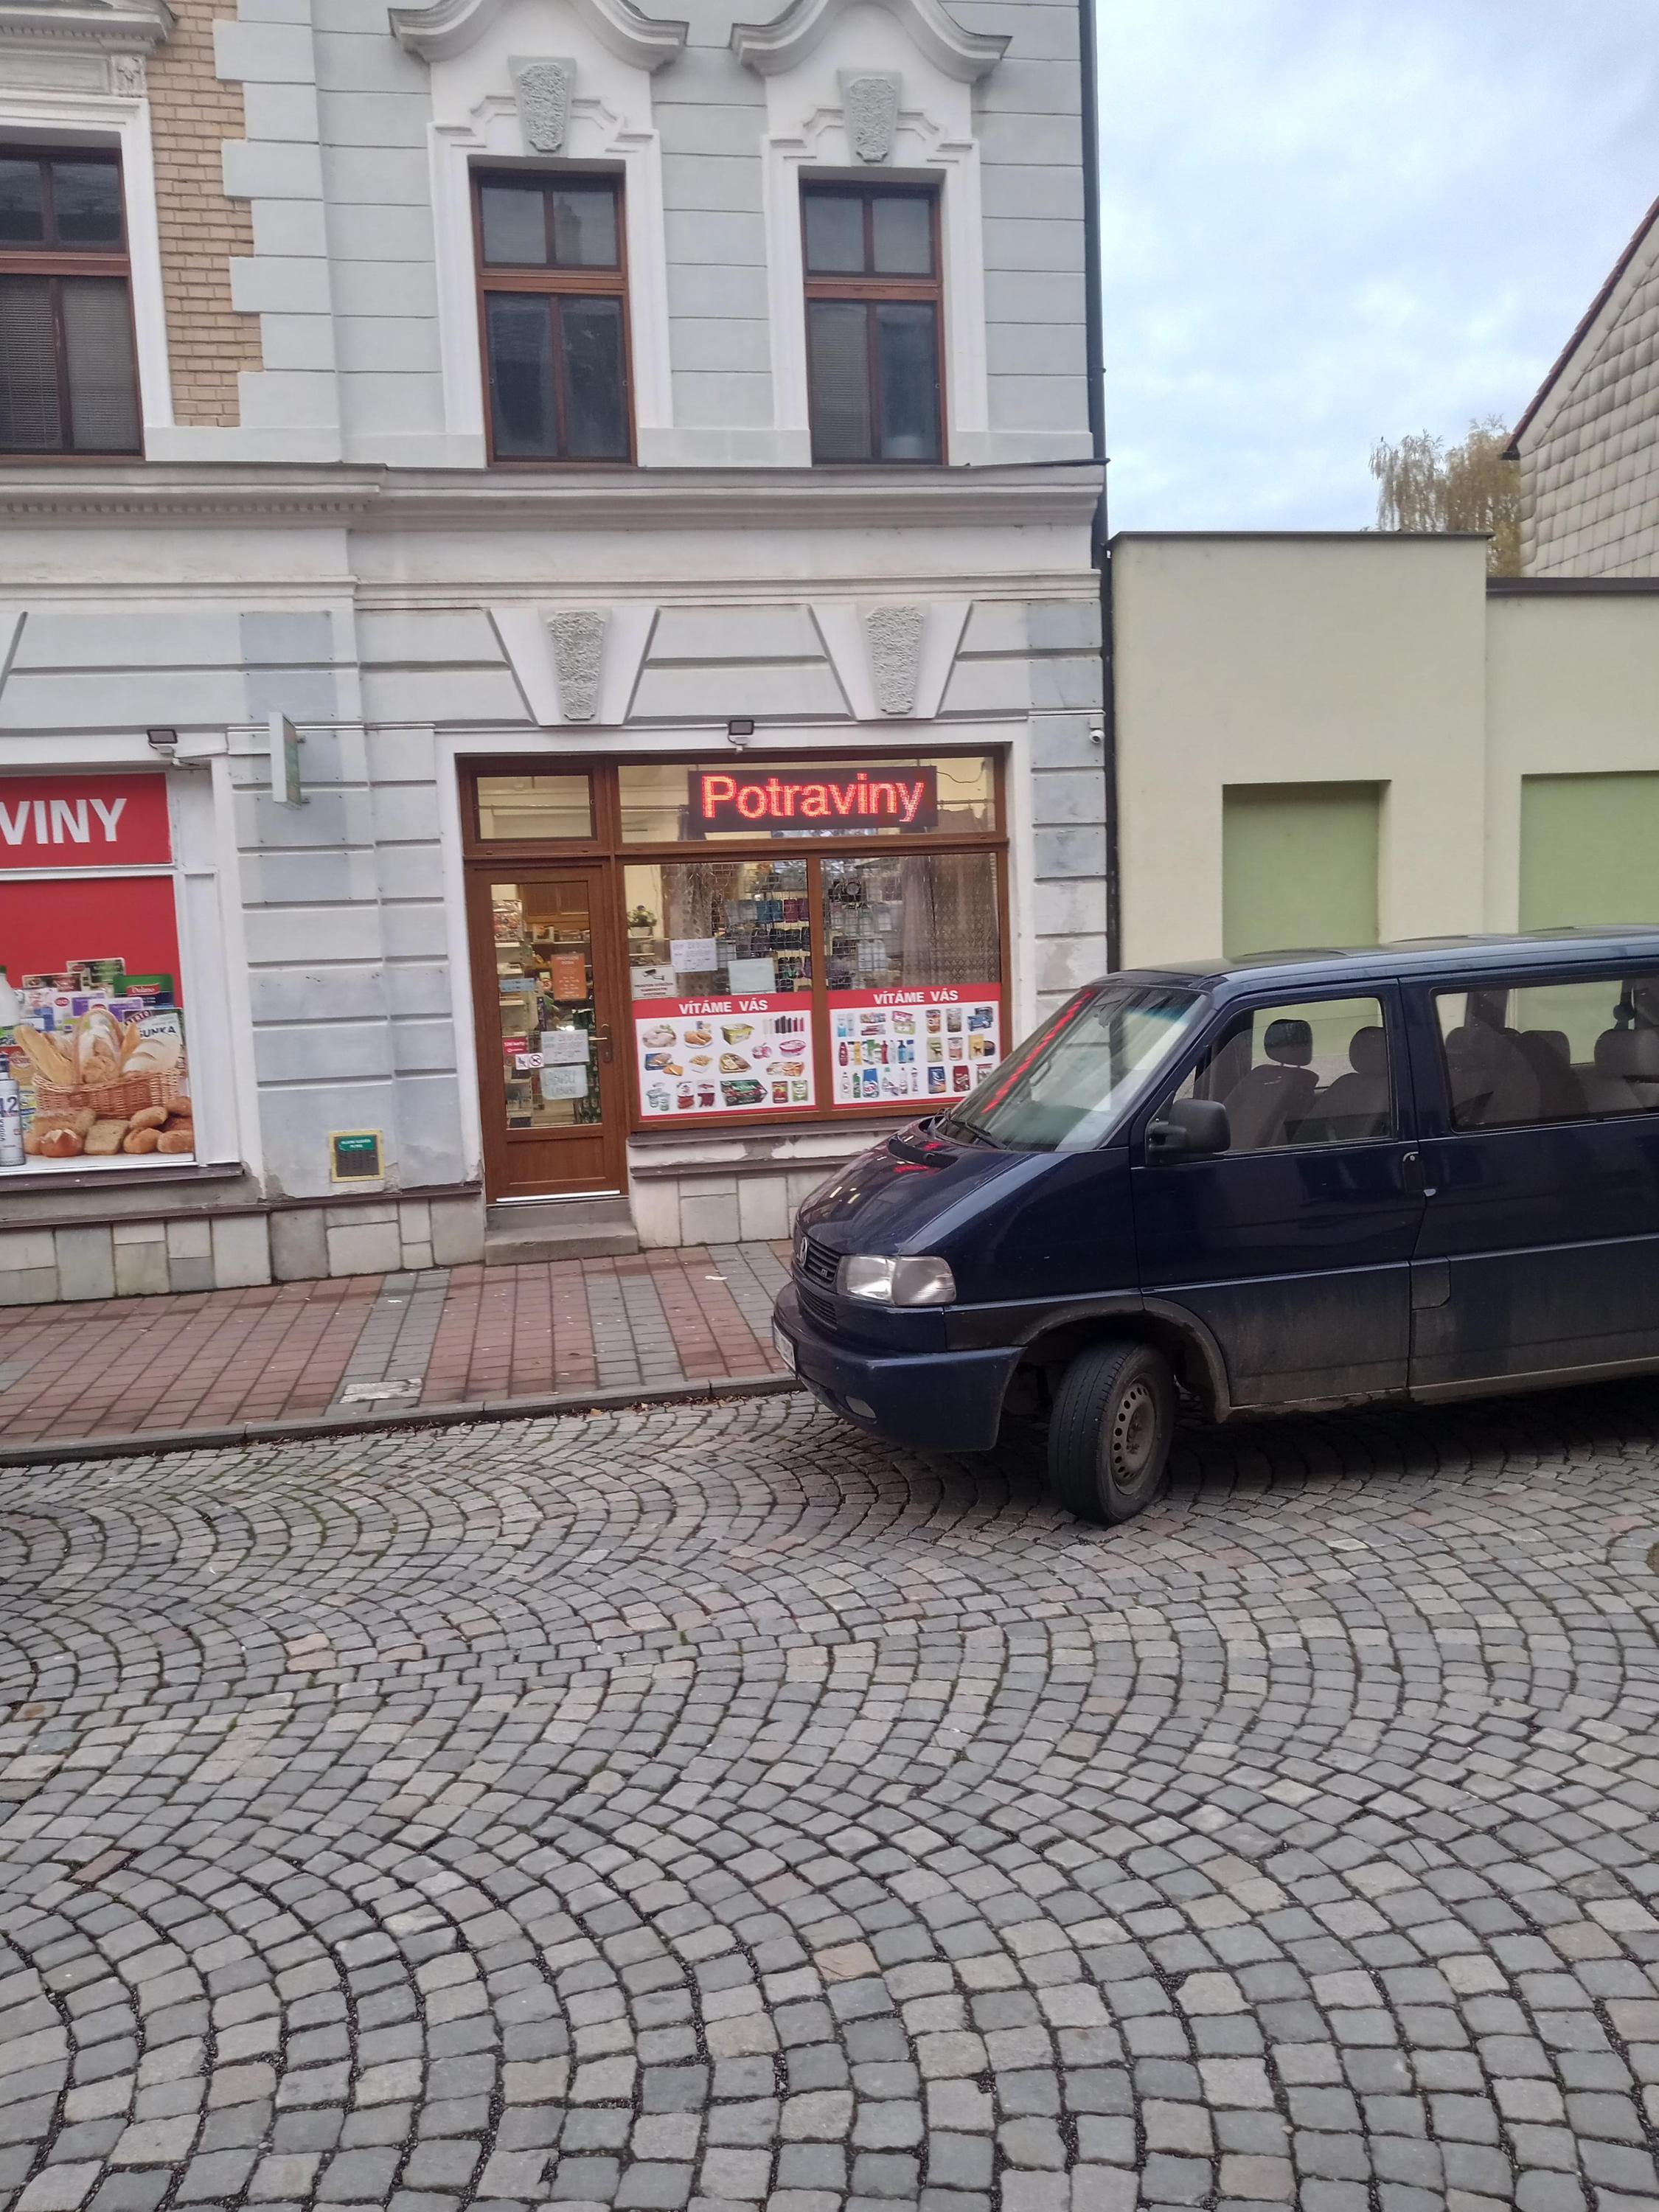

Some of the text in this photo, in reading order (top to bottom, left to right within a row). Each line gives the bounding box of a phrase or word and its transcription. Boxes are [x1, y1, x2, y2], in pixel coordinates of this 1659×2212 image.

[702, 773, 924, 822] Potraviny
[0, 799, 127, 845] VINY
[678, 998, 768, 1015] VÍTÁME VÁS
[873, 988, 959, 1004] VÍTÁME VÁS
